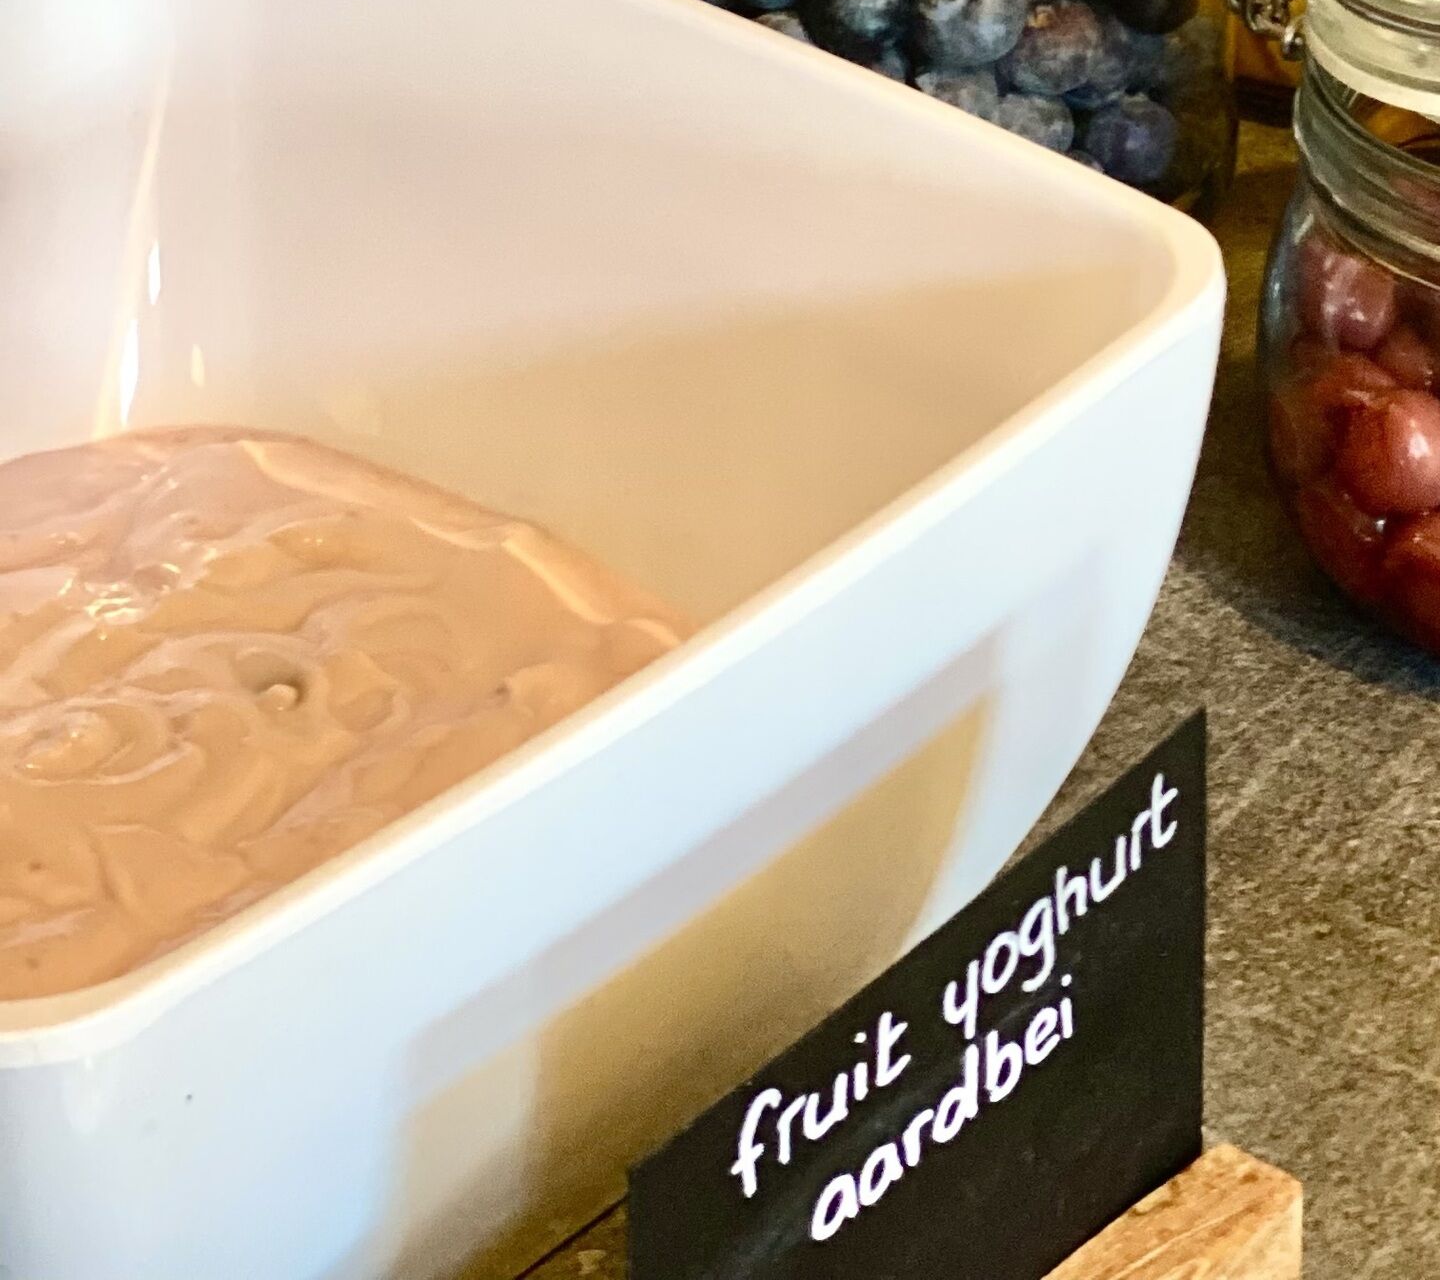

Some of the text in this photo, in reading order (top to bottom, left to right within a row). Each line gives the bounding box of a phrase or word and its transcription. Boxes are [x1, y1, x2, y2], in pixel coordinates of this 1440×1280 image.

[731, 772, 1178, 1198] fruit yoghurt
[810, 975, 1074, 1242] aardbei
